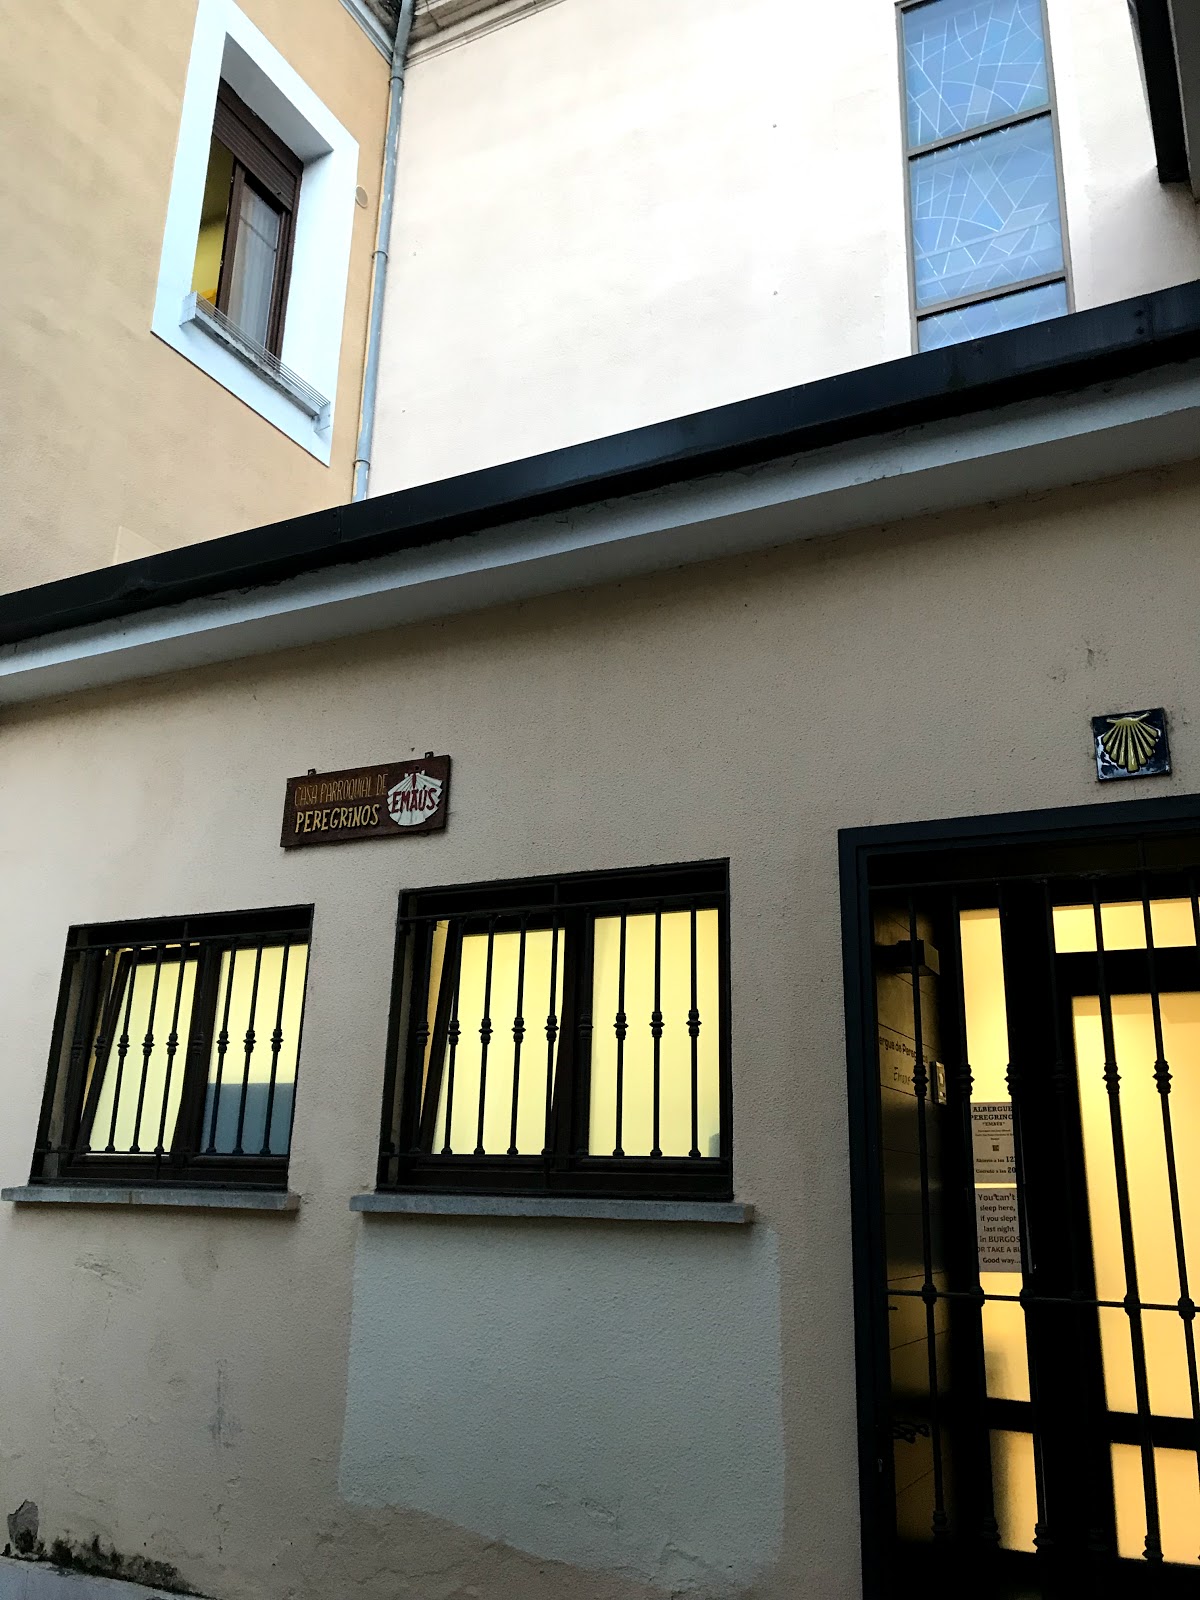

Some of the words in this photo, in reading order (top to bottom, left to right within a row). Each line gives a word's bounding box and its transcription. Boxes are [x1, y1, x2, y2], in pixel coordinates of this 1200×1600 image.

[319, 776, 372, 804] PARROQUIAL
[977, 1193, 994, 1201] You
[995, 1192, 1016, 1201] can't
[979, 1204, 997, 1213] sleep
[998, 1204, 1016, 1212] here,
[1000, 1215, 1017, 1223] slept
[997, 1225, 1015, 1234] night
[988, 1235, 1021, 1243] BURGOS
